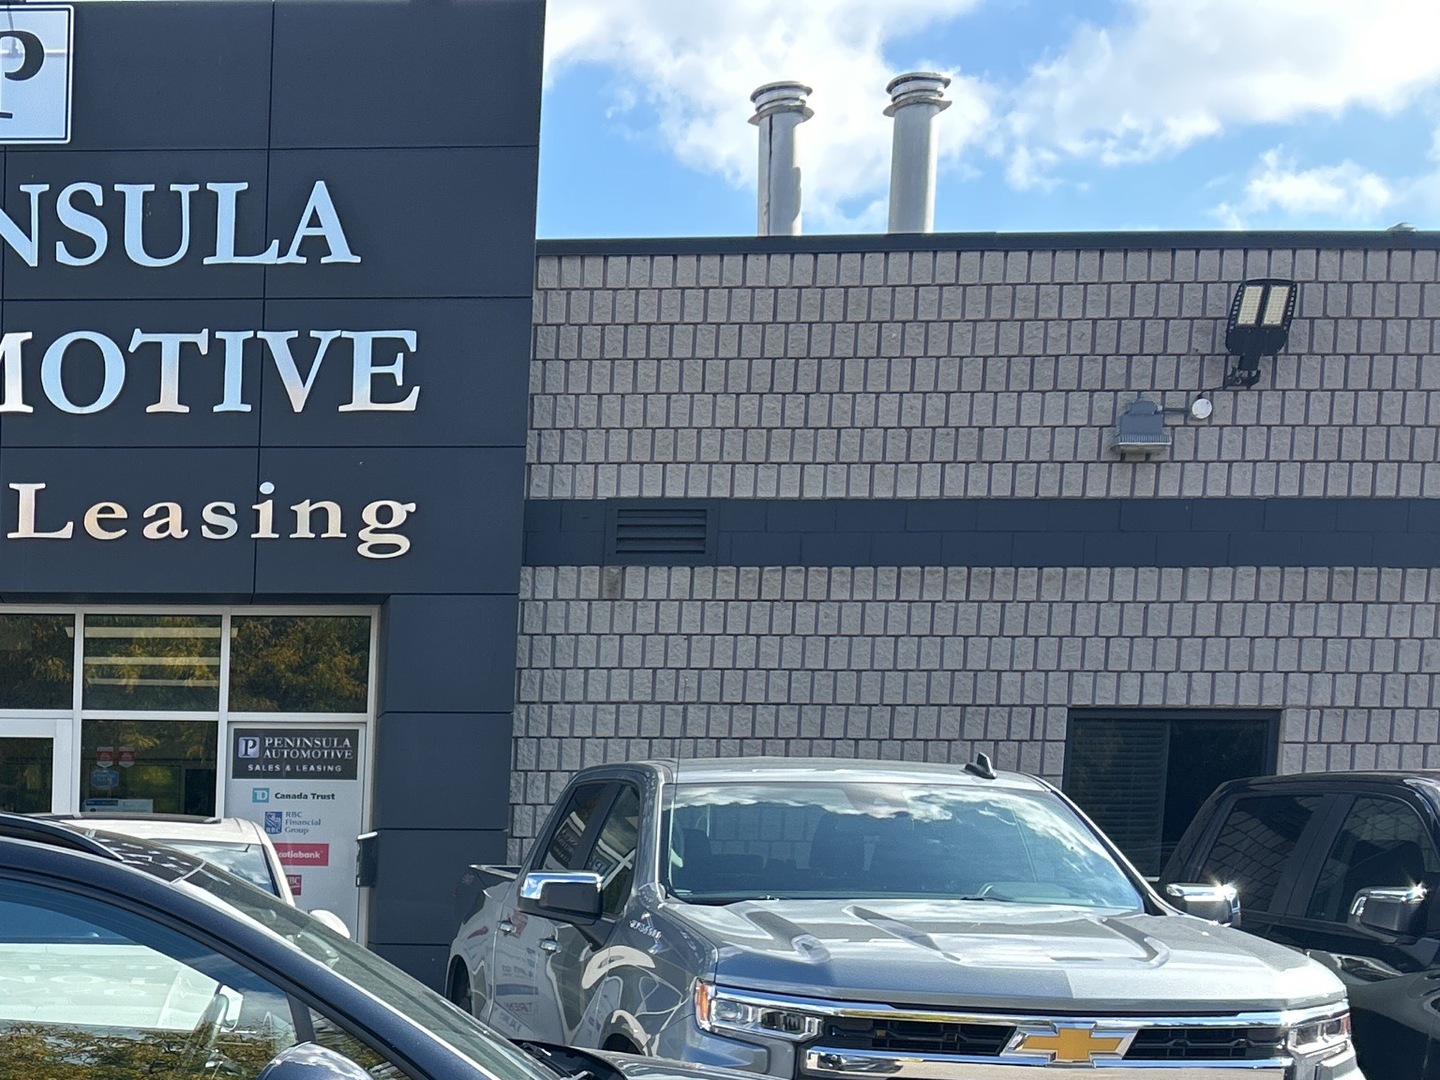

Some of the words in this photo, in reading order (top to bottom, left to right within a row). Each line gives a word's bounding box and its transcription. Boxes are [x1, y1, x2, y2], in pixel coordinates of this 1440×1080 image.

[7, 482, 417, 559] Leasing
[242, 739, 257, 757] P
[264, 737, 352, 749] PENINSULA
[263, 749, 353, 760] AUTOMOTIVE
[248, 764, 281, 772] SALES
[285, 764, 291, 772] &
[296, 764, 342, 772] LEASING
[274, 792, 308, 800] Canada
[285, 827, 309, 835] Group
